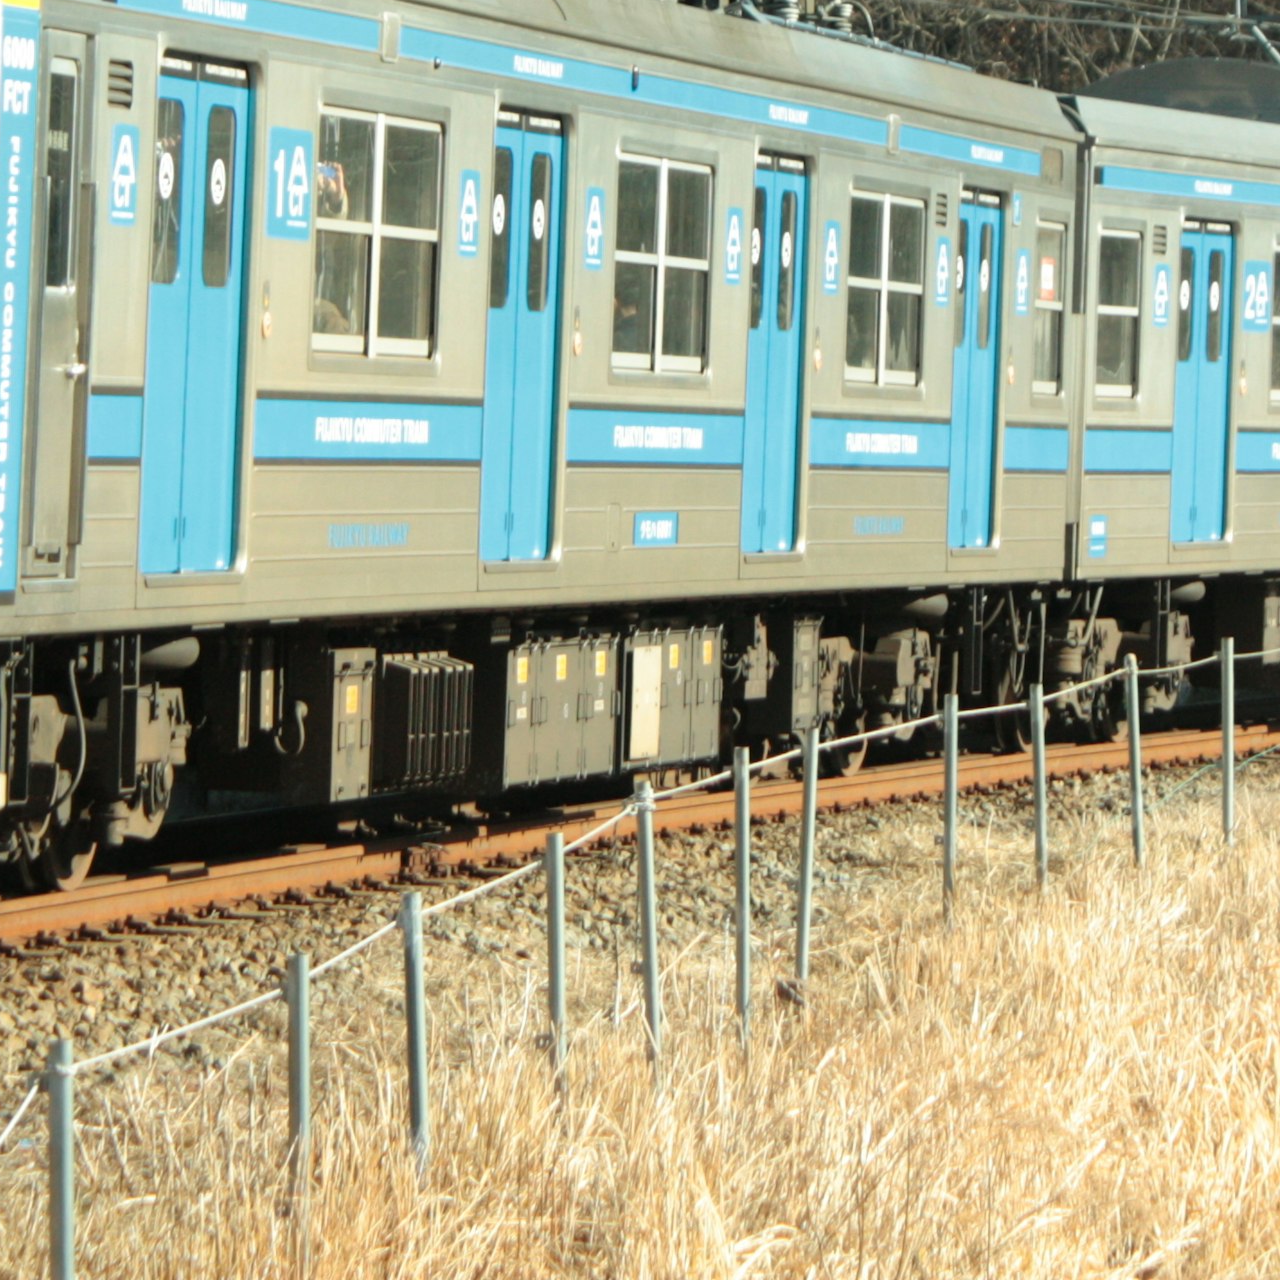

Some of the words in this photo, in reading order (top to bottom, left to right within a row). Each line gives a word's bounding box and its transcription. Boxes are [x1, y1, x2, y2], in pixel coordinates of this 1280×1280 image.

[3, 35, 35, 70] 6000
[2, 79, 31, 114] FCT
[274, 149, 286, 218] 1
[5, 135, 21, 269] FUJIKYU
[315, 417, 353, 442] FUJIKYU
[354, 418, 401, 443] COMMUTER
[402, 419, 429, 444] TRAIN
